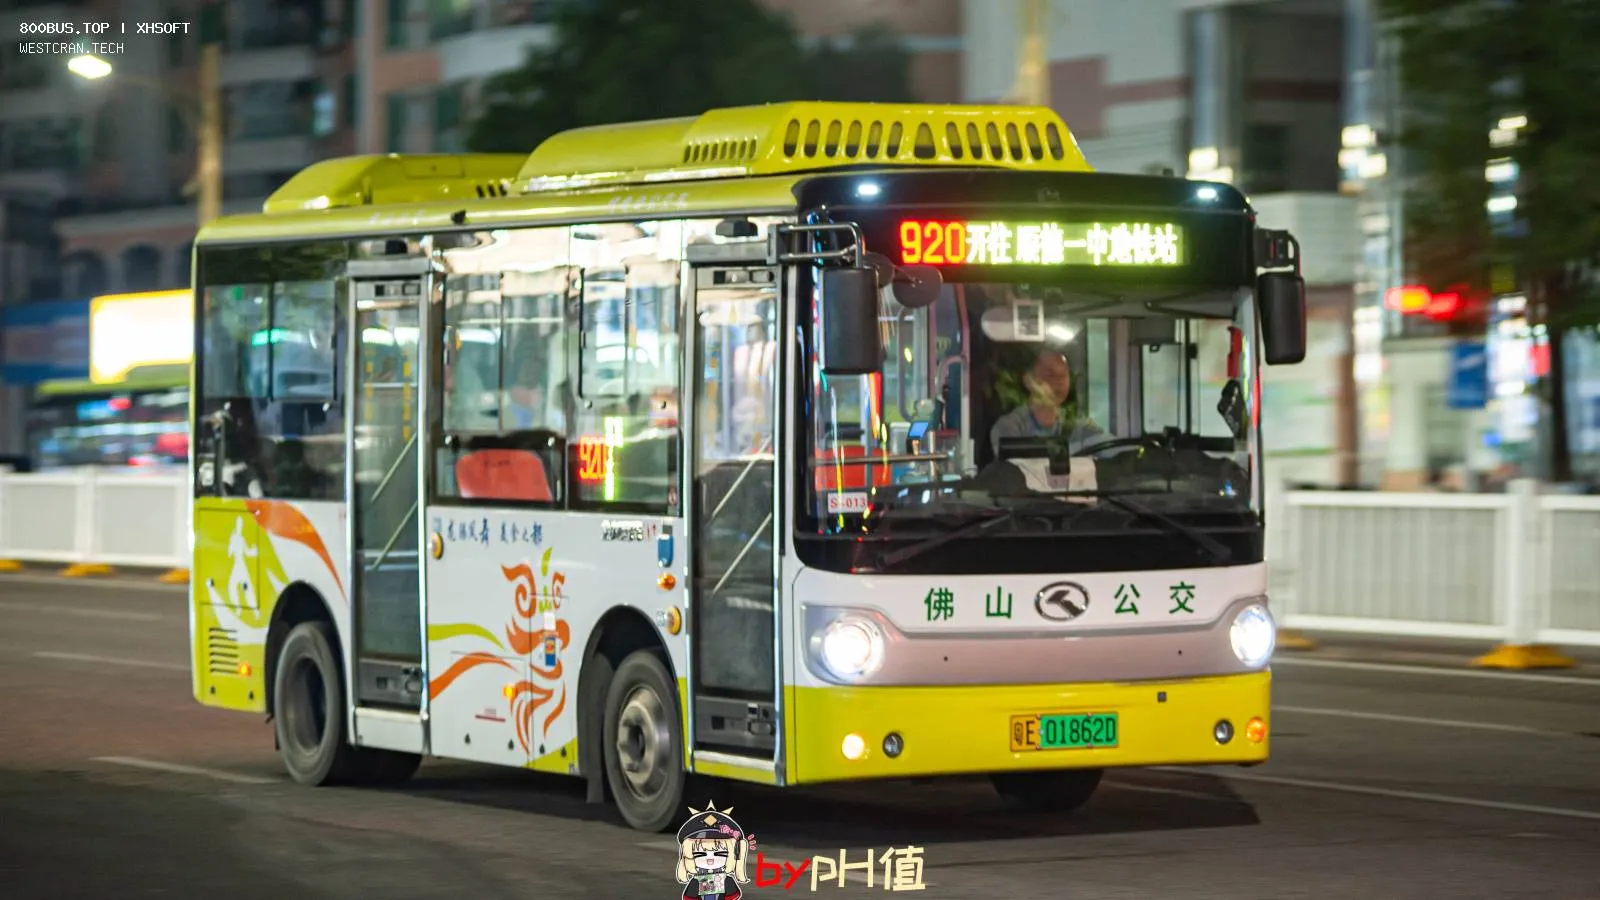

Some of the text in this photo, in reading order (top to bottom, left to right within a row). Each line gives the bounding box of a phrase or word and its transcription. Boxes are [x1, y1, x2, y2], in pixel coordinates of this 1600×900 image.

[900, 221, 966, 264] 920
[924, 581, 1196, 621] 佛山 公交
